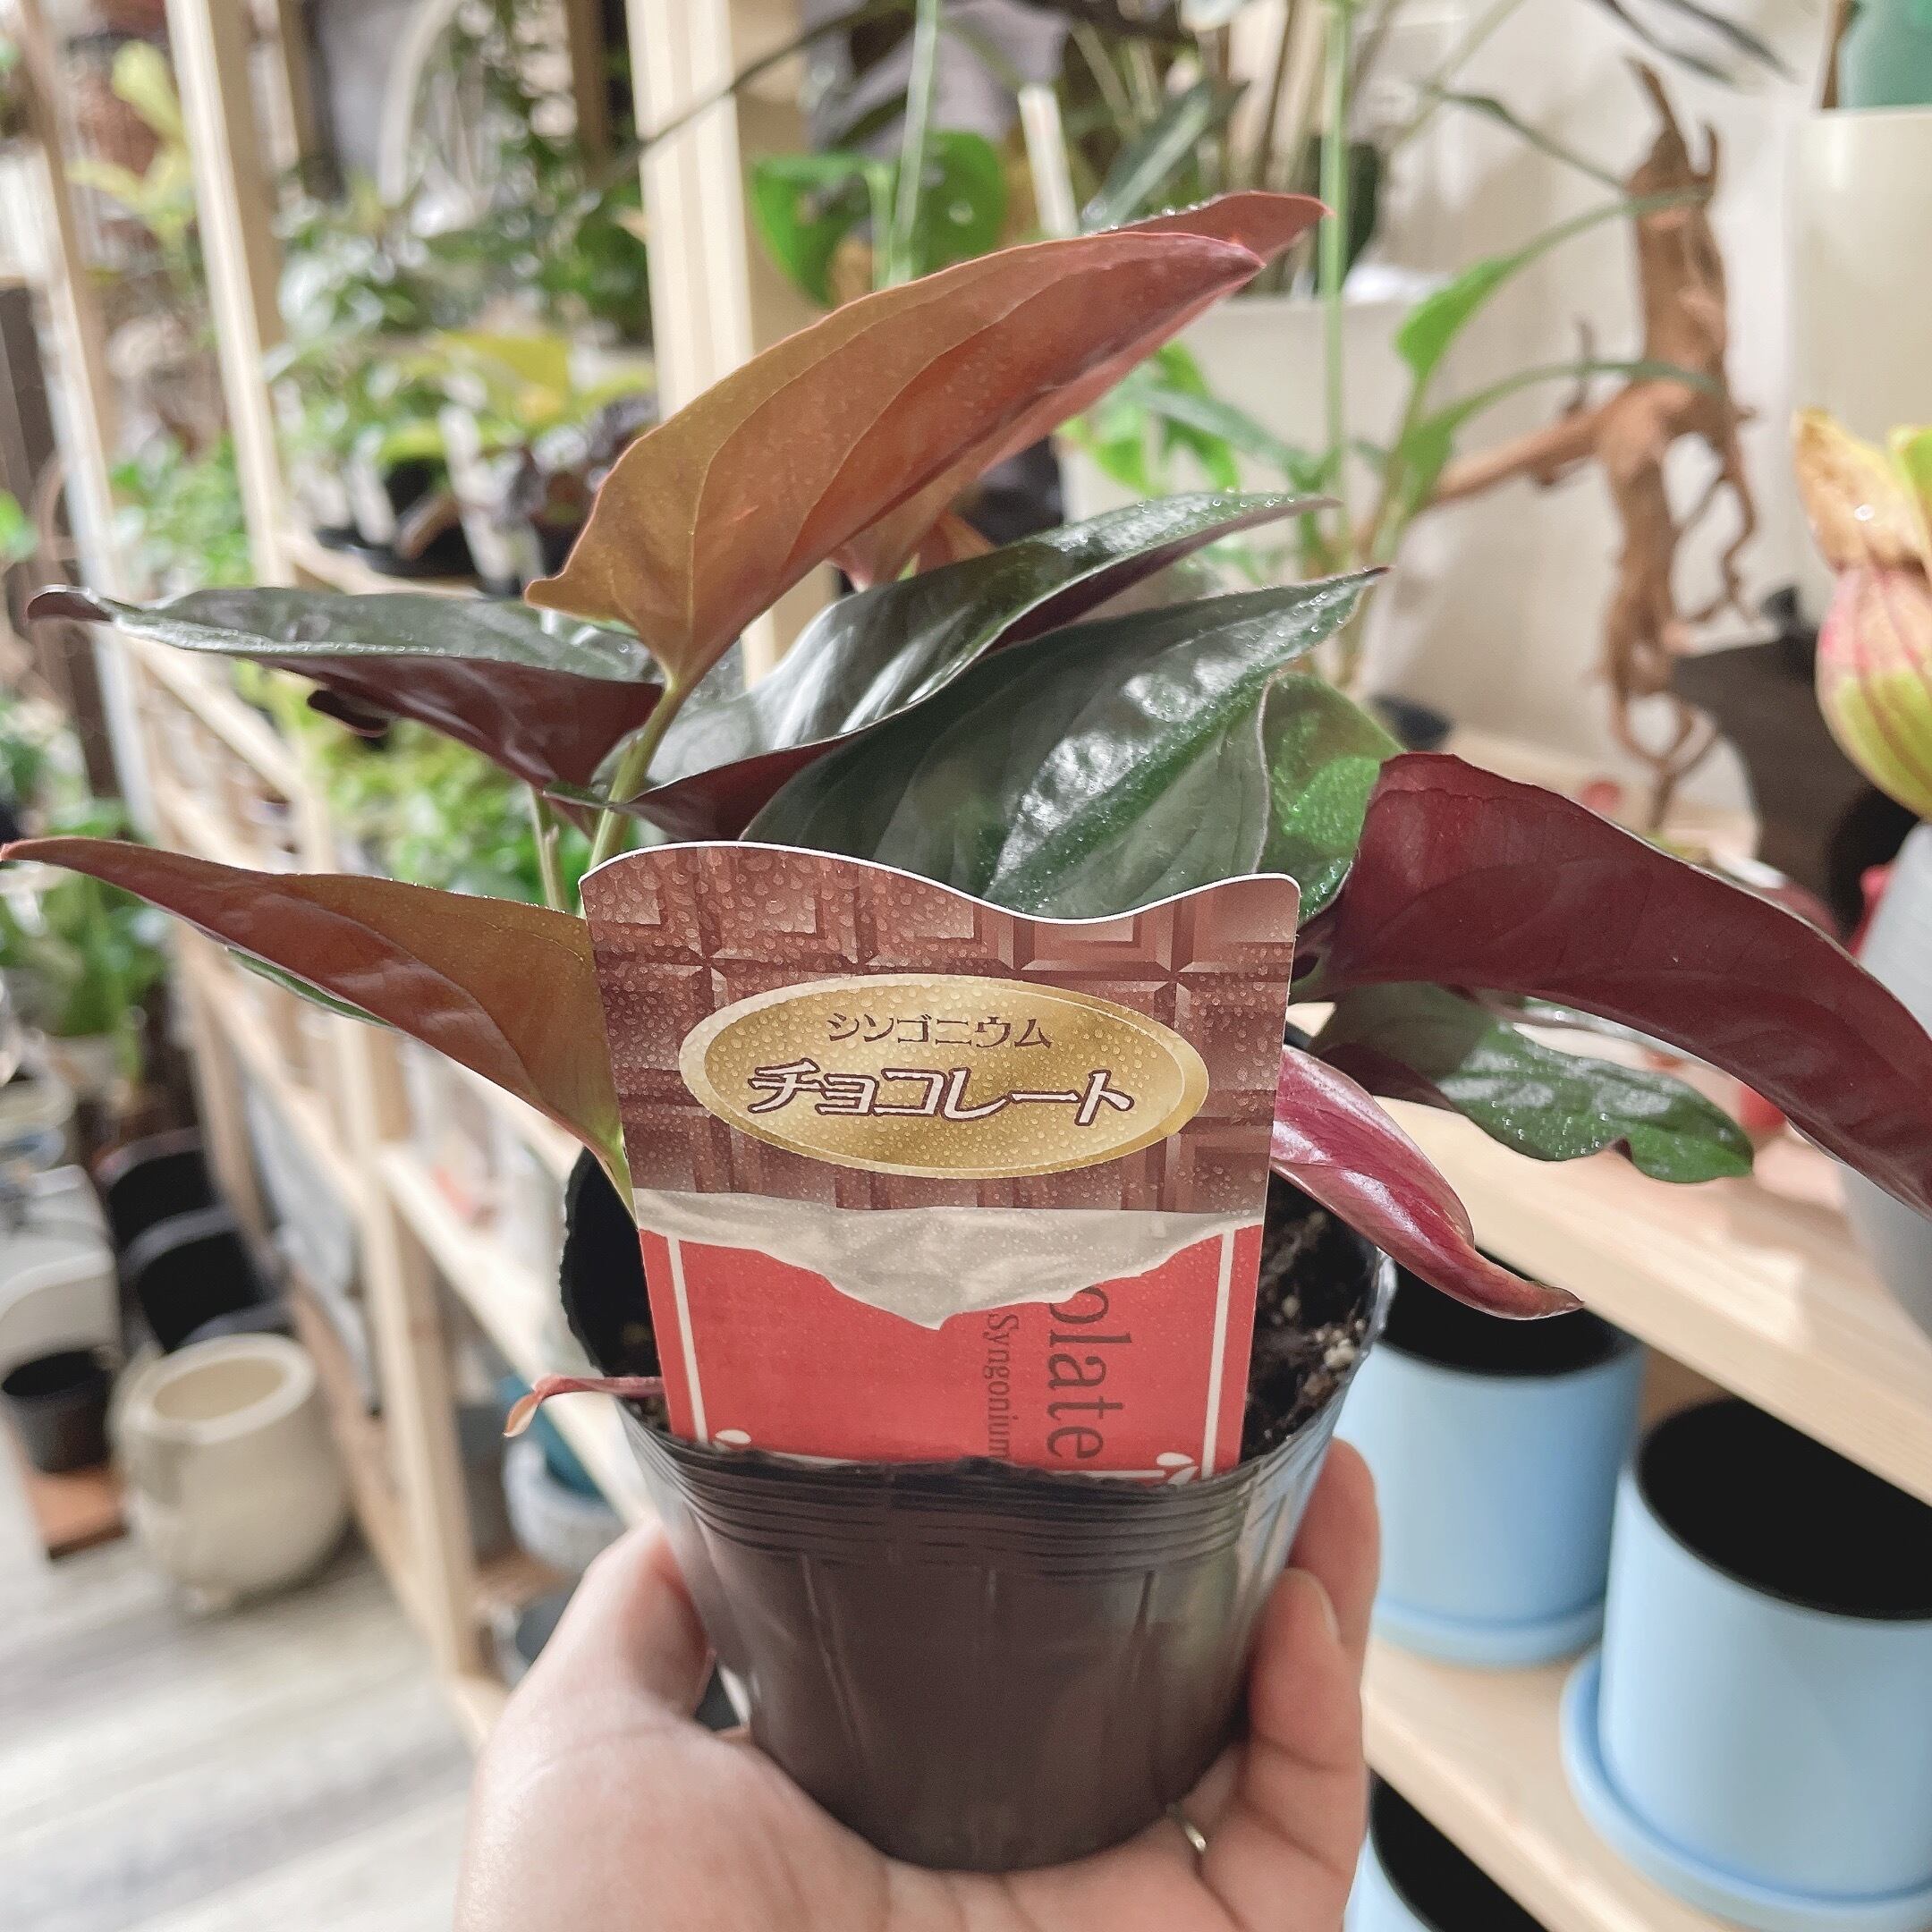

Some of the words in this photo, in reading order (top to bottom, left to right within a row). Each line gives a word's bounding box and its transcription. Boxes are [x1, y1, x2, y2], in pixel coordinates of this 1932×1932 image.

[826, 1013, 1053, 1049] シンゴニウム
[747, 1058, 1136, 1126] チョコレート
[983, 1312, 1020, 1460] Syngonium
